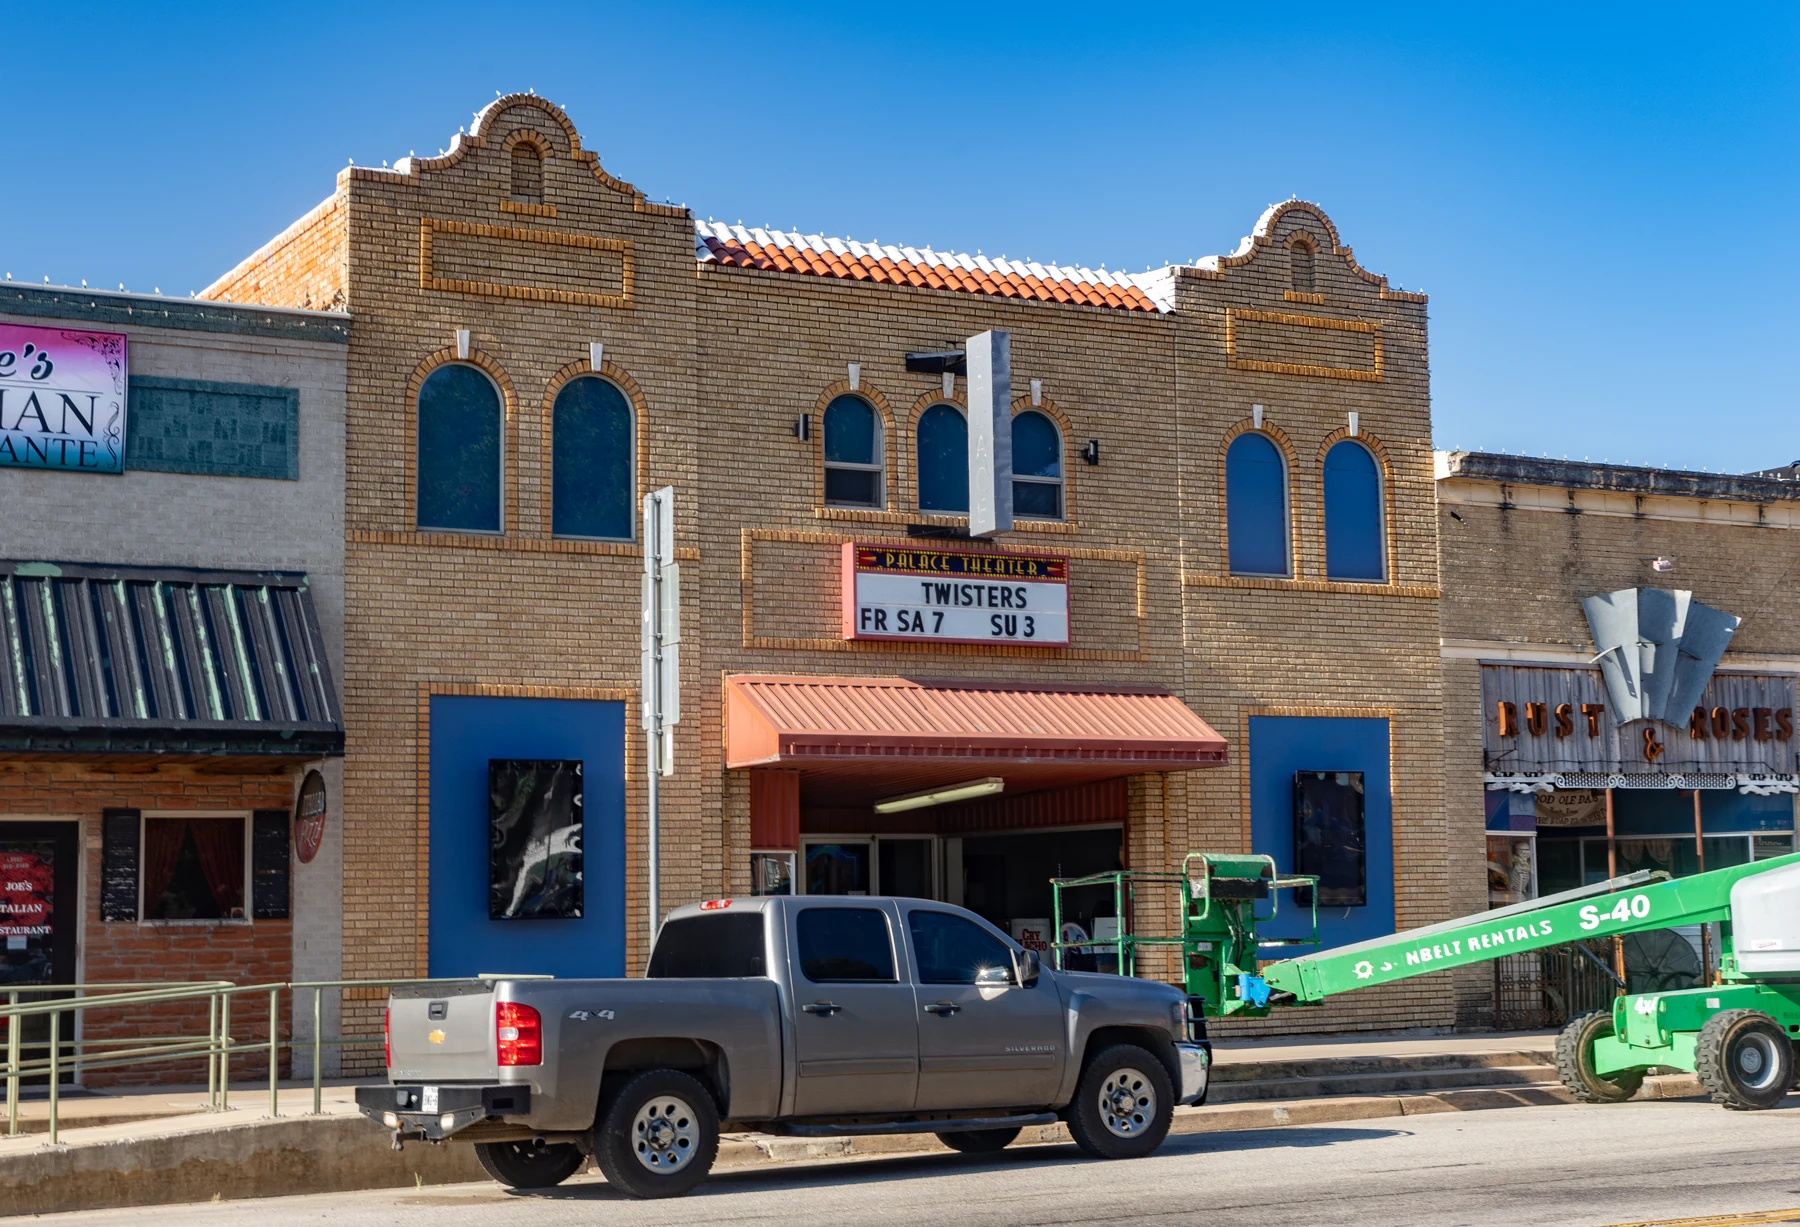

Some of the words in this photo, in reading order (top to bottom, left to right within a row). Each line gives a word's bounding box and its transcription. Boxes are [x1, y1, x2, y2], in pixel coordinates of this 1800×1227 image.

[0, 434, 99, 468] ANTE
[886, 552, 950, 571] PALACE
[962, 556, 1038, 576] THEATER
[921, 582, 1027, 609] TWISTERS
[860, 607, 888, 631] FR
[897, 609, 925, 633] SA
[932, 611, 945, 633] 7
[990, 614, 1018, 637] SU
[1023, 615, 1035, 638] 3
[1497, 701, 1605, 738] RUST
[1642, 727, 1665, 760] &
[1690, 705, 1793, 741] ROSES
[1558, 795, 1577, 805] OLE
[5, 879, 33, 892] JOE'S
[1579, 894, 1651, 931] S-40
[1022, 928, 1041, 941] CRY
[1468, 919, 1553, 951] RENTALS
